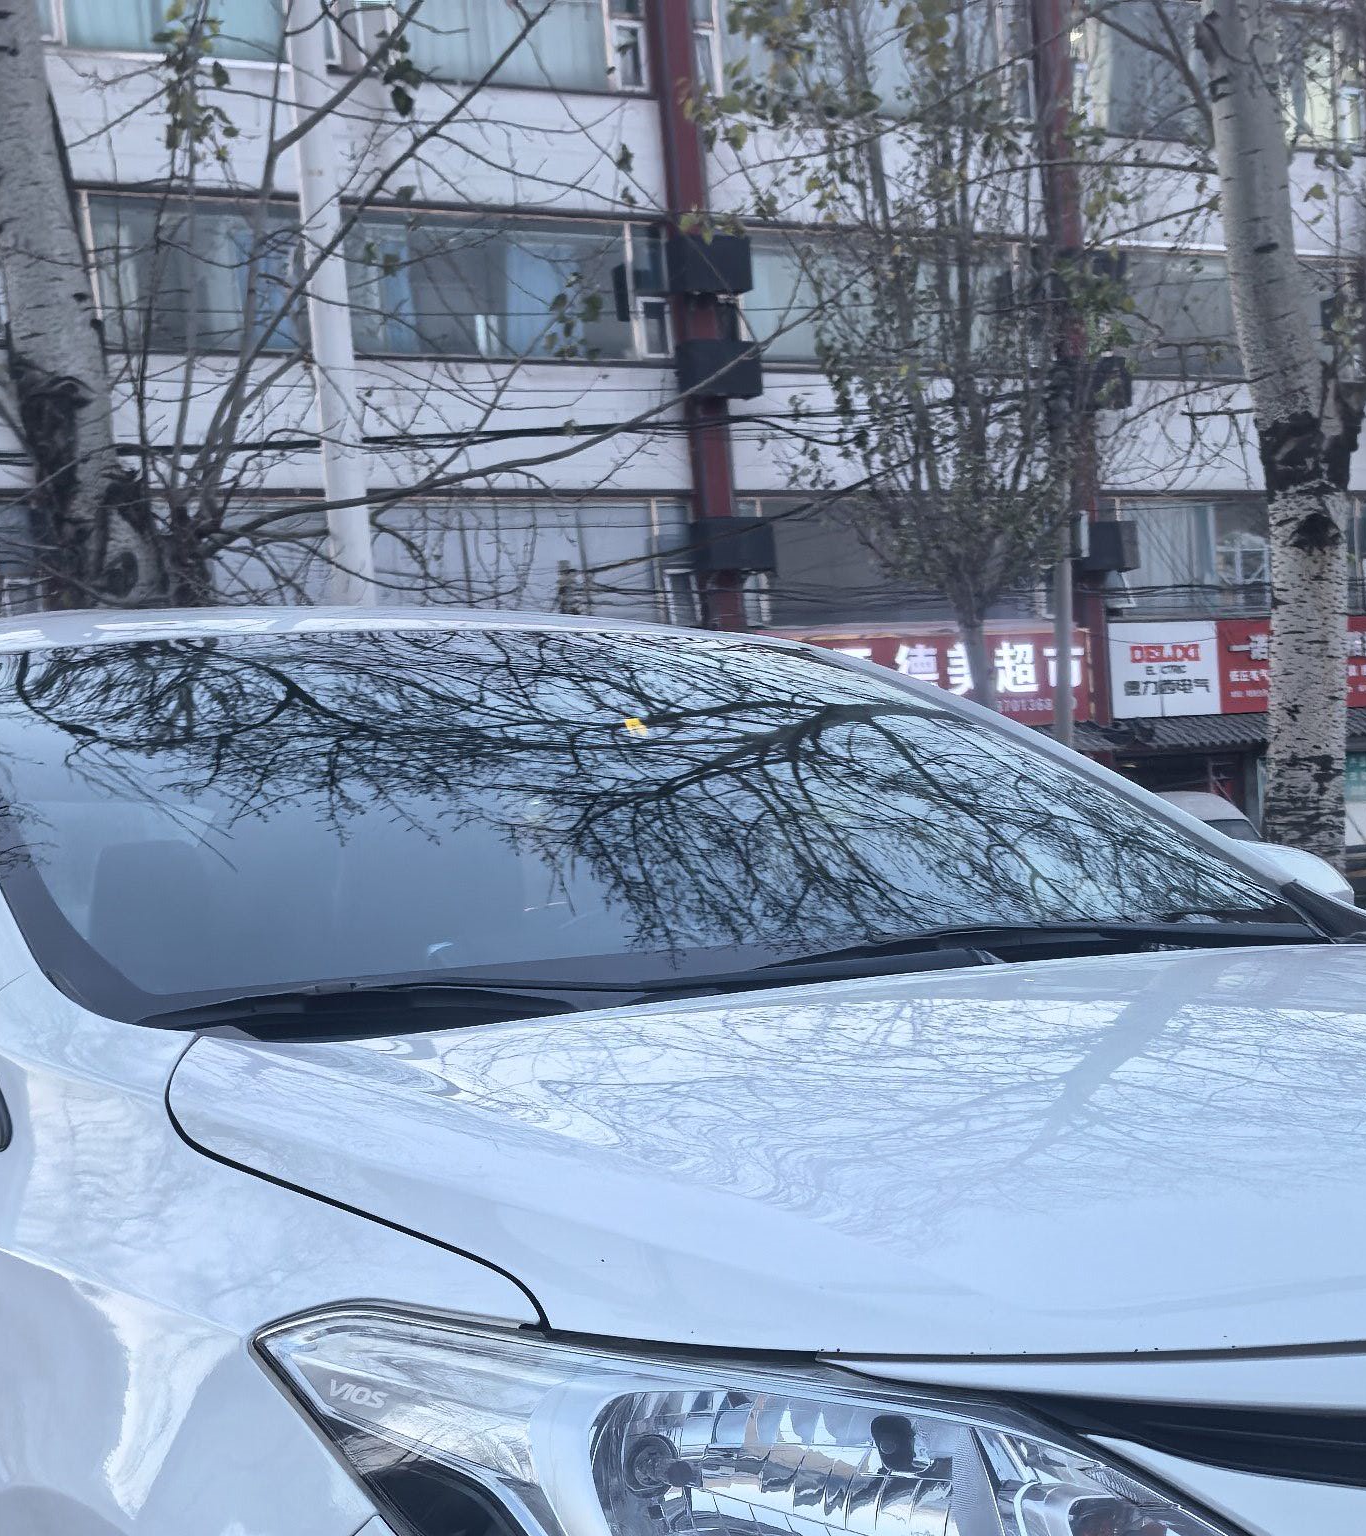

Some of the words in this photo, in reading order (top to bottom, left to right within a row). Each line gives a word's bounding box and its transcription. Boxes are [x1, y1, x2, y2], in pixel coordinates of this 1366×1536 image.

[833, 641, 1084, 695] 德美超市
[330, 1379, 389, 1409] VIOS
